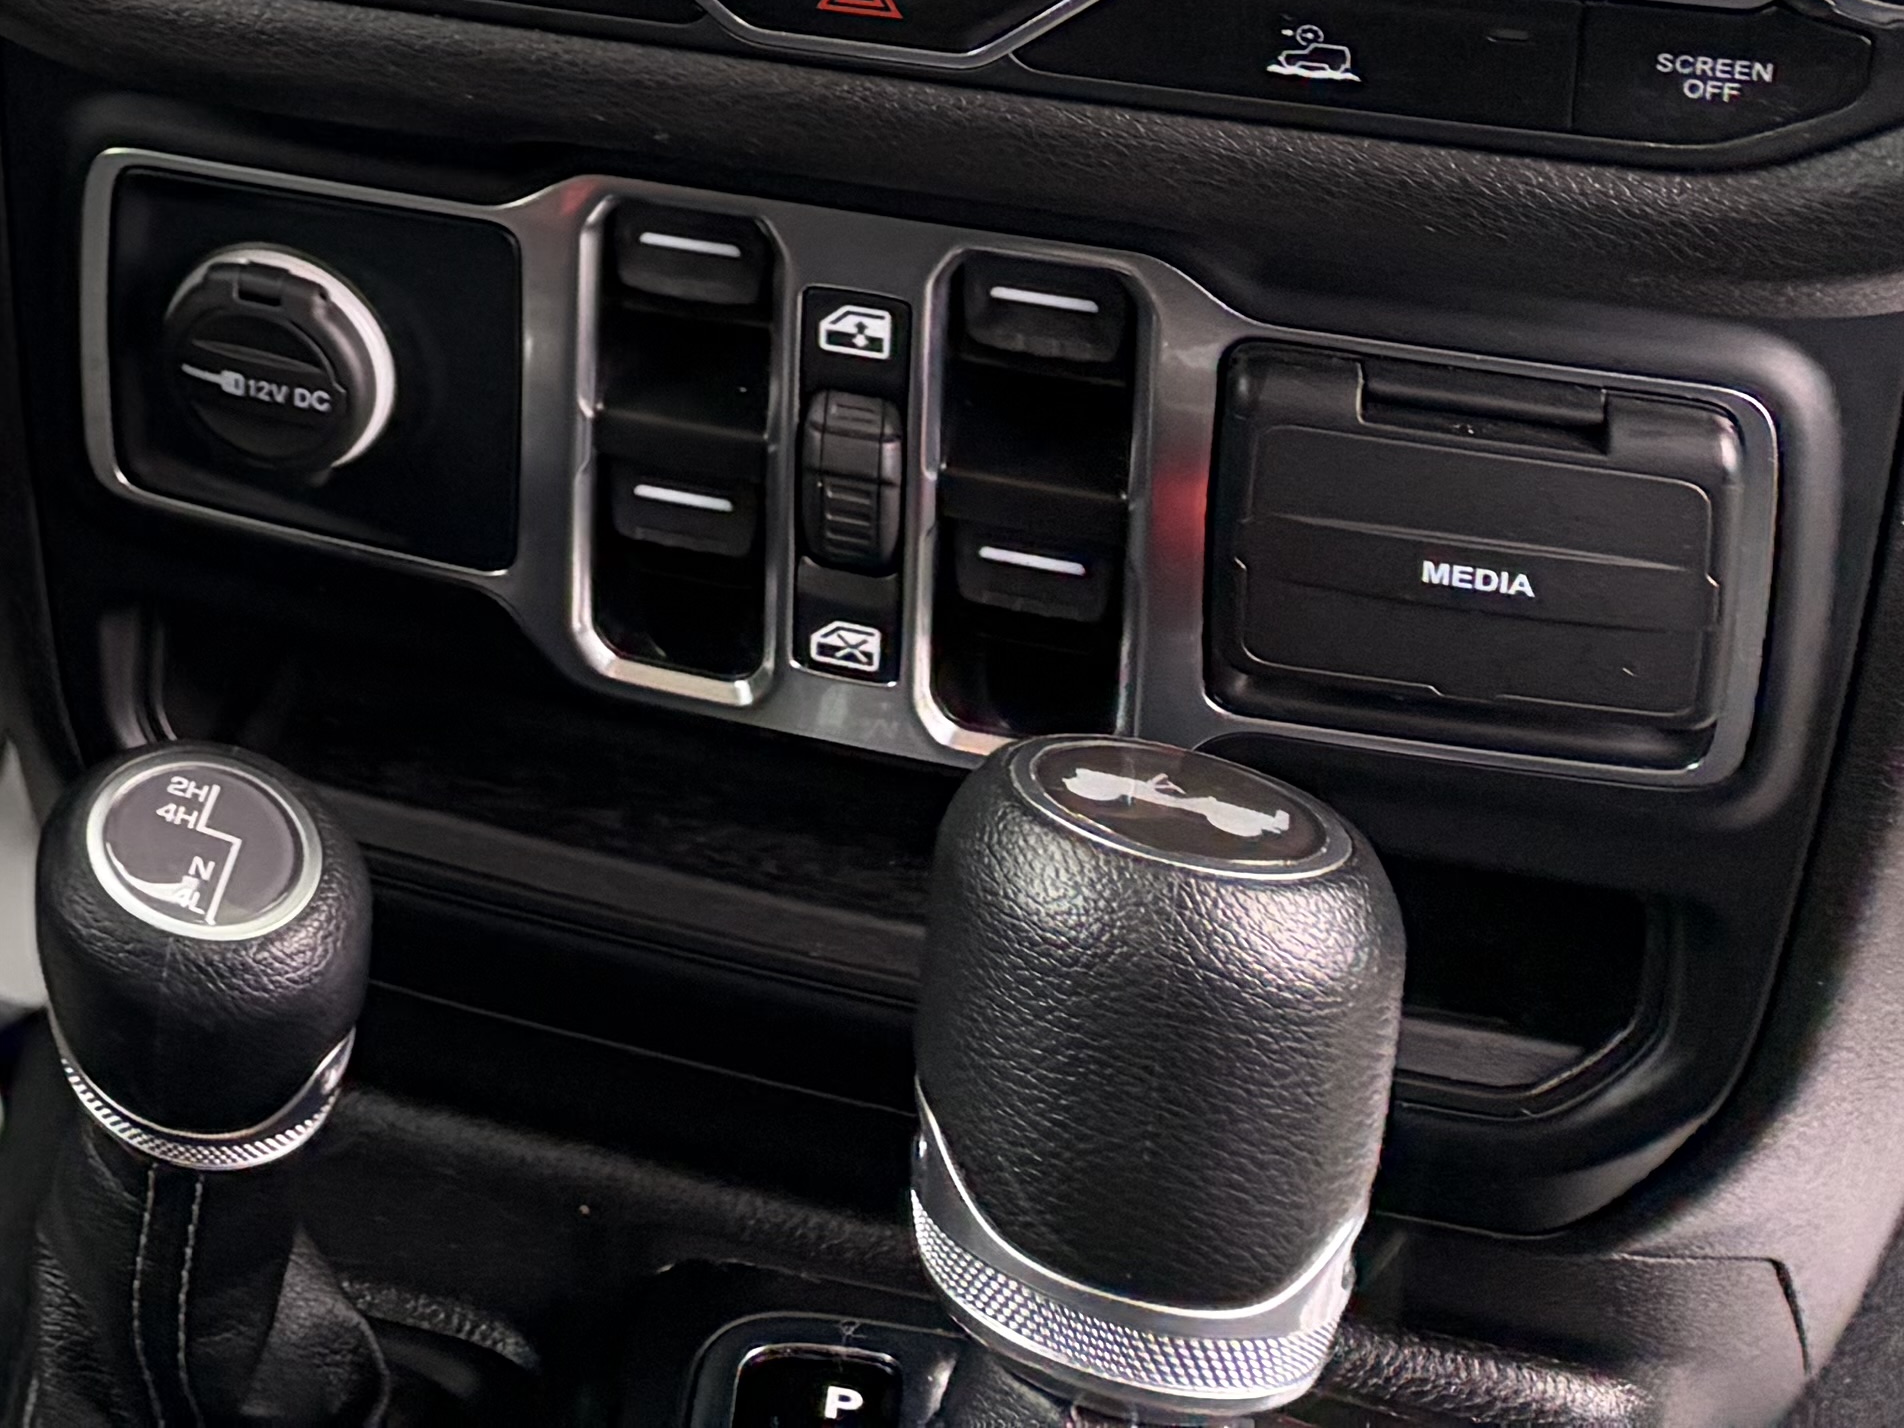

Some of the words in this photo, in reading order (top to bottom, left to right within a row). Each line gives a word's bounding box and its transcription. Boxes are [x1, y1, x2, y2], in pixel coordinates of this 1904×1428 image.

[1655, 51, 1774, 84] SCREEN
[1682, 80, 1741, 104] OFF
[247, 379, 289, 404] 12V
[293, 387, 331, 413] DC
[1420, 559, 1536, 600] MEDIA
[167, 775, 210, 803] 2H
[156, 802, 199, 830] 4H
[188, 855, 216, 881] N
[176, 887, 206, 915] 4L
[824, 1384, 864, 1420] P
